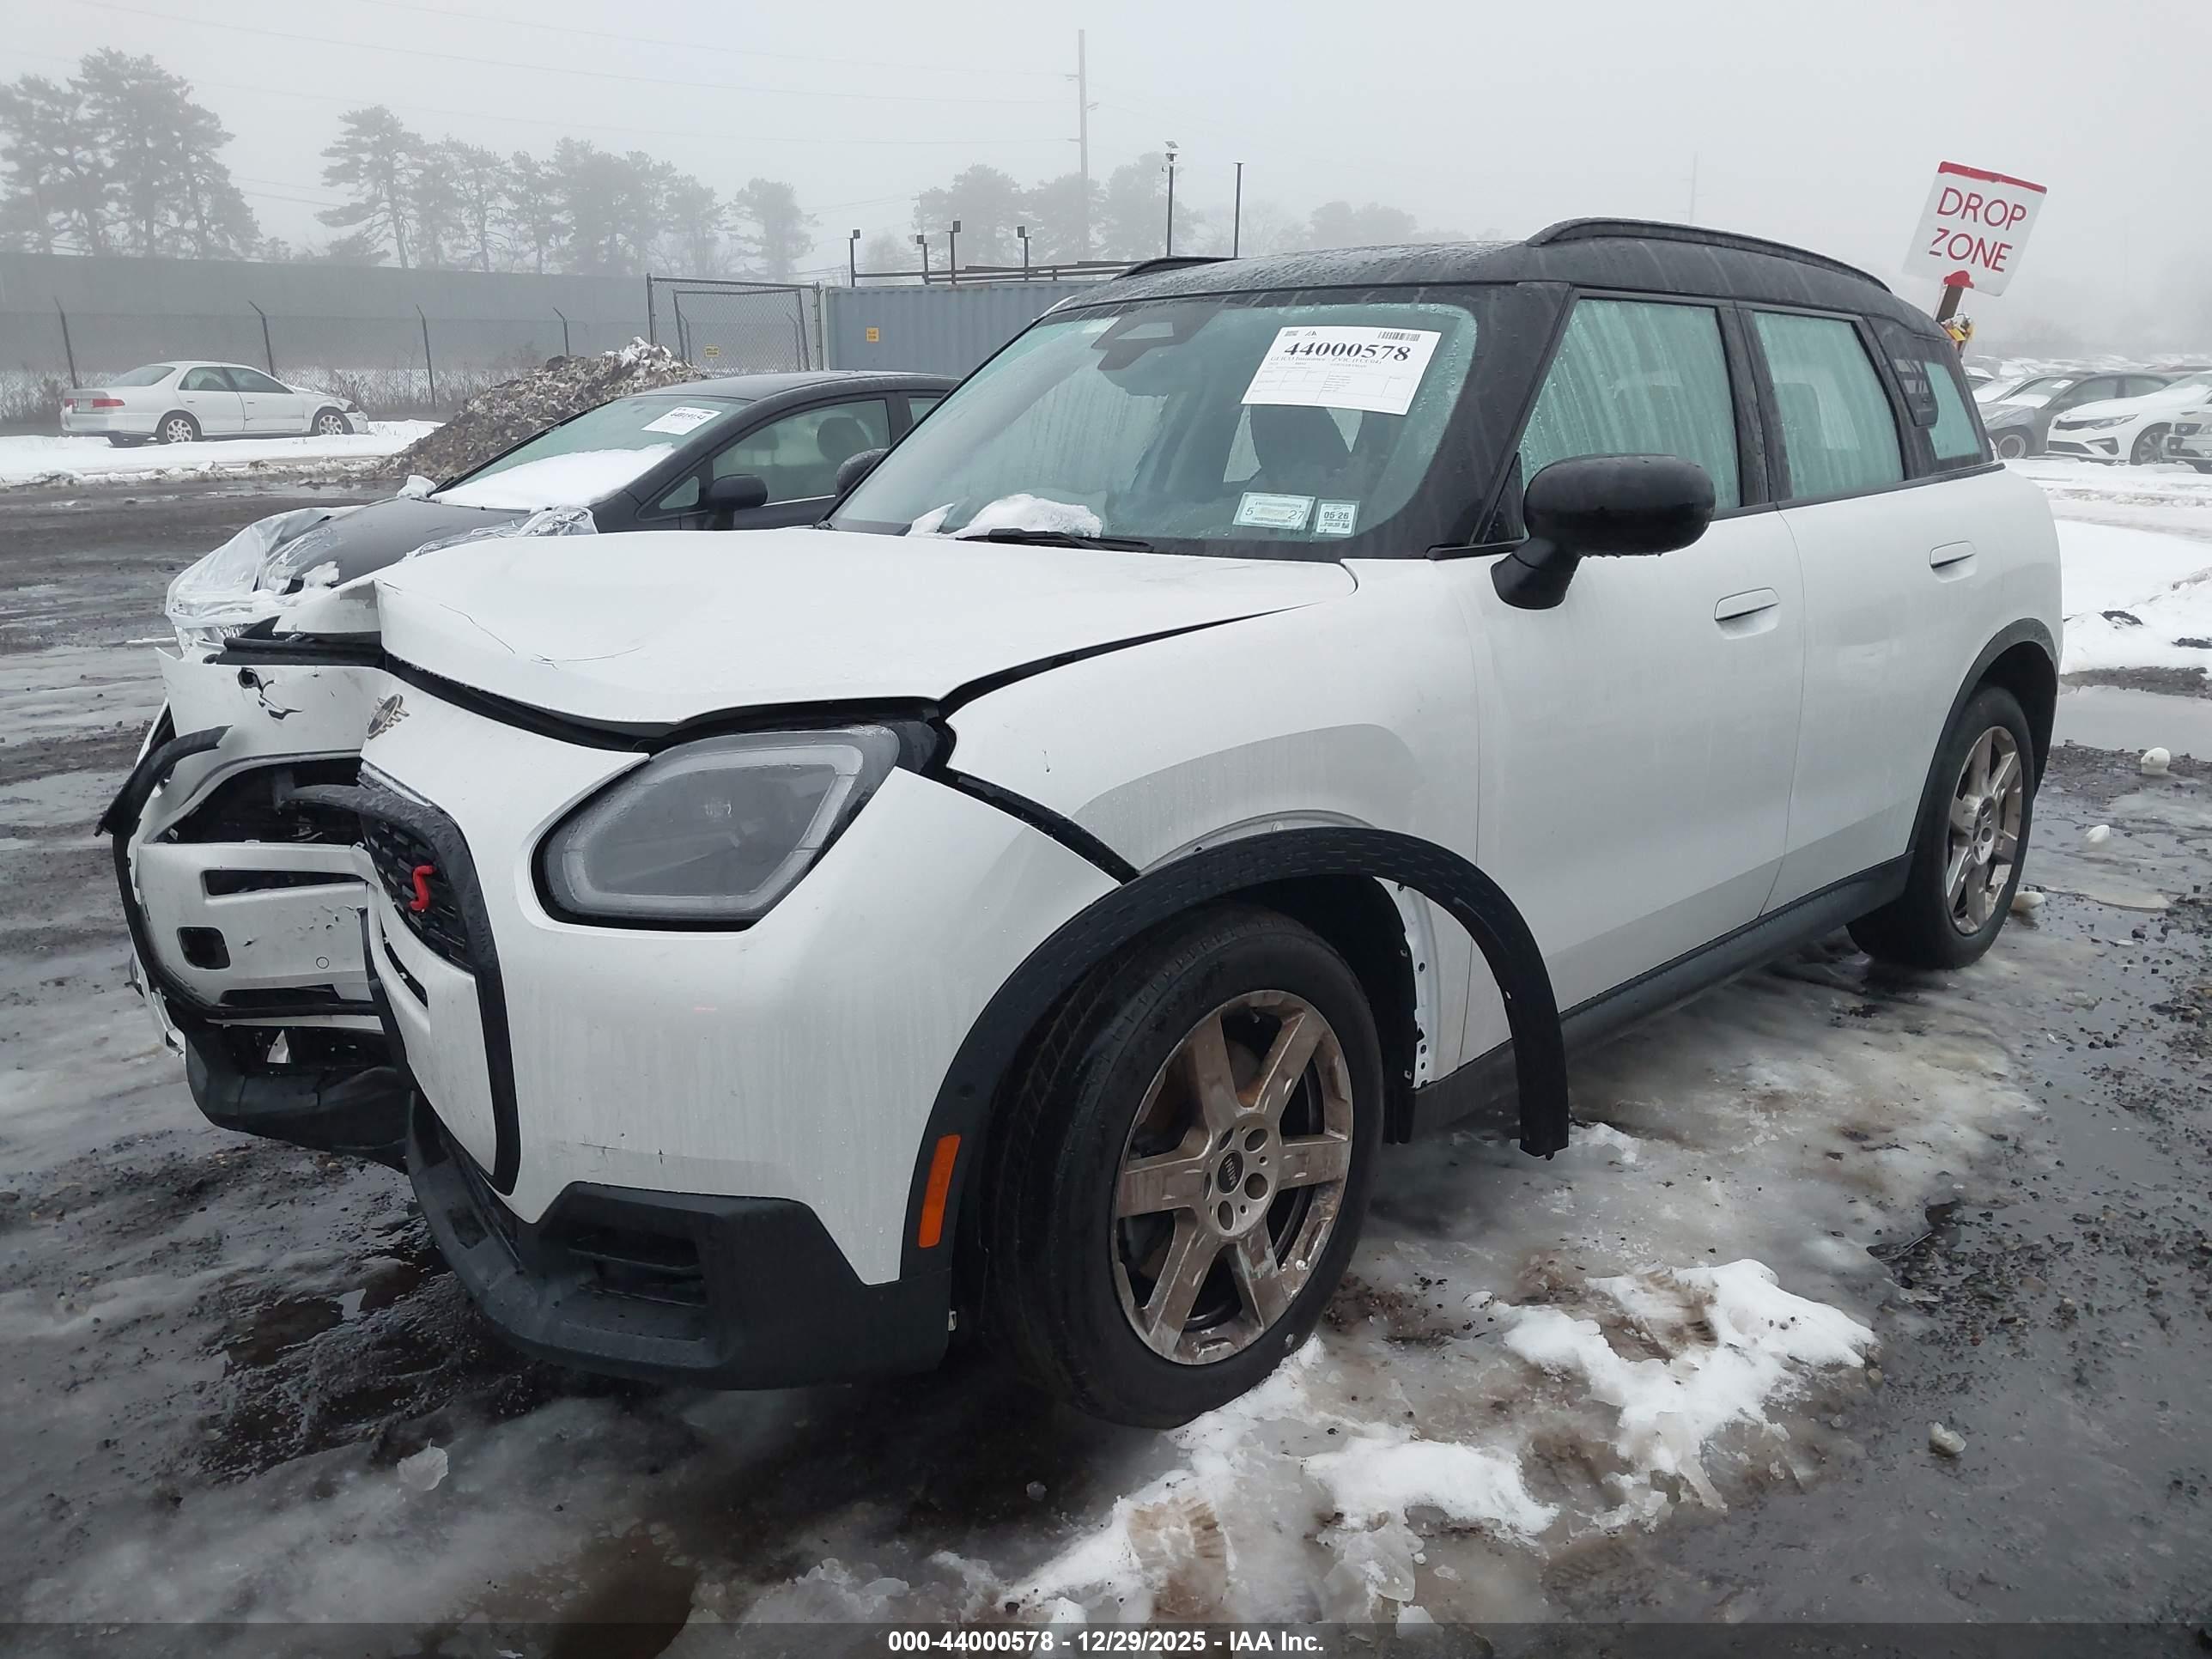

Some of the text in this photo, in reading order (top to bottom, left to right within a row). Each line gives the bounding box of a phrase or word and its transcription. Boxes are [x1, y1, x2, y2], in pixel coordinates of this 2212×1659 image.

[1936, 186, 2027, 231] DROP
[1929, 228, 2013, 272] ZONE
[1285, 342, 1411, 362] 44000578
[1245, 507, 1254, 516] 5
[1288, 509, 1304, 520] 27
[1323, 511, 1335, 520] 05
